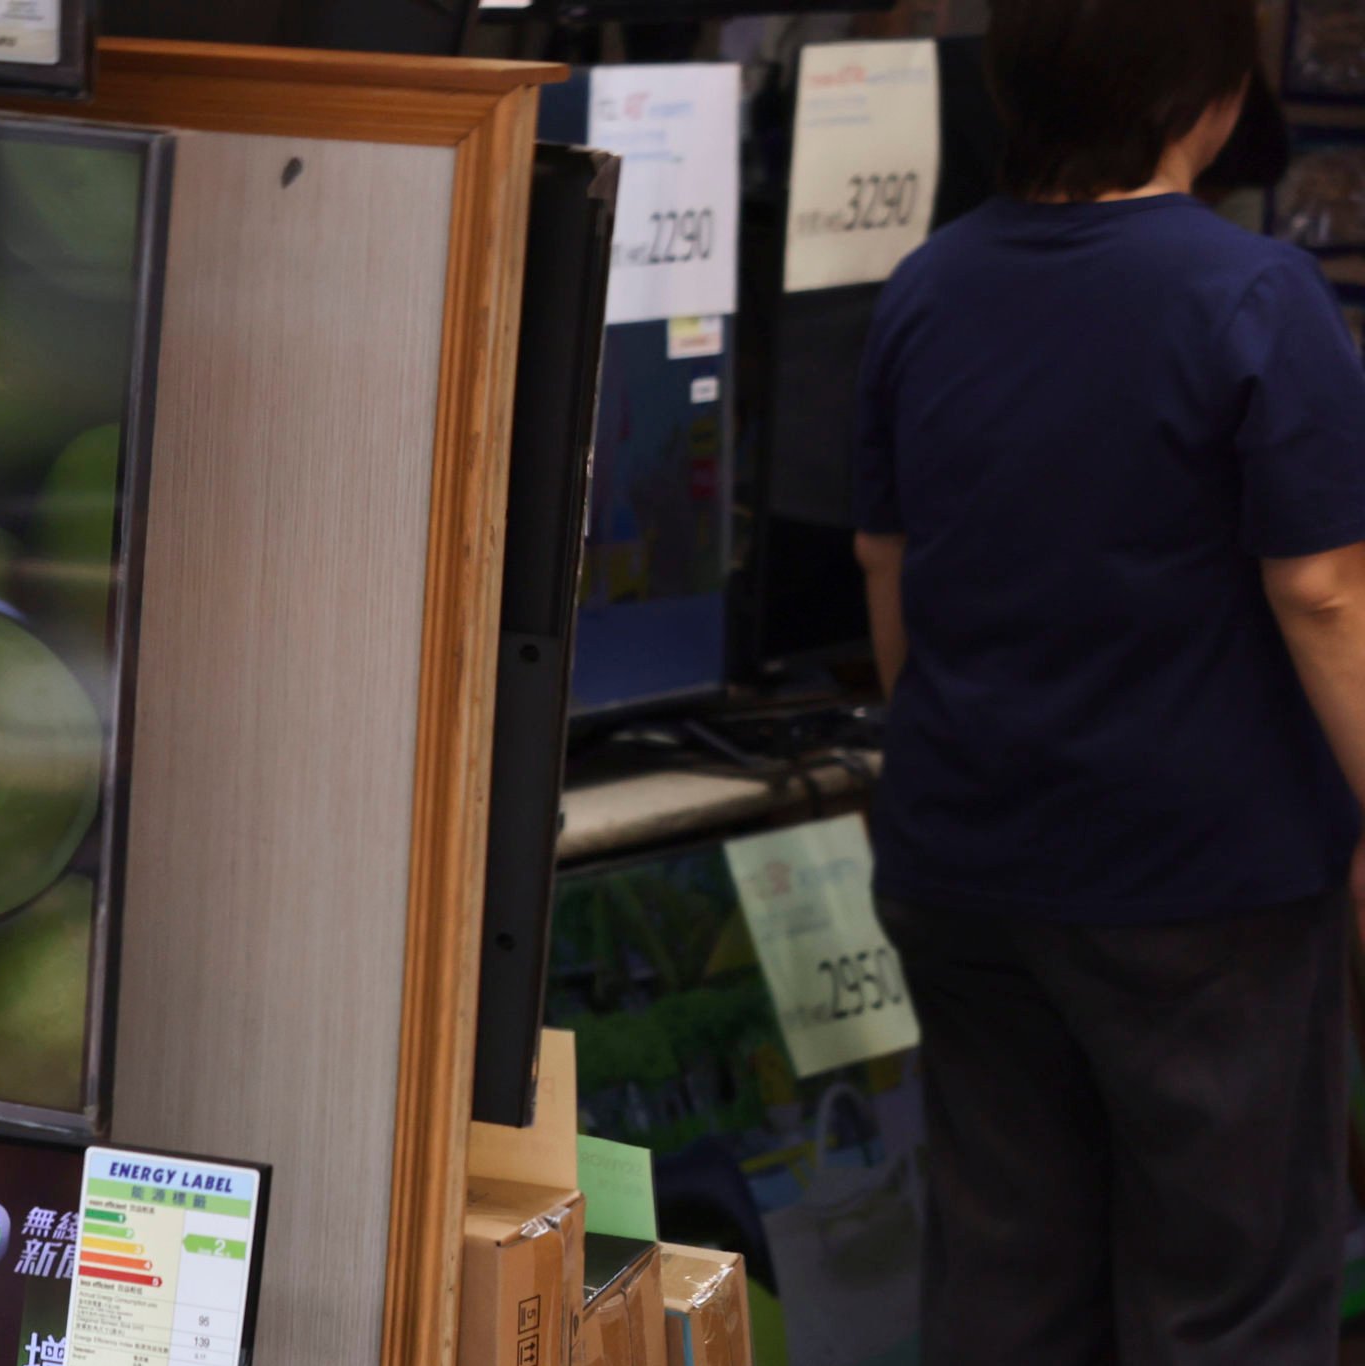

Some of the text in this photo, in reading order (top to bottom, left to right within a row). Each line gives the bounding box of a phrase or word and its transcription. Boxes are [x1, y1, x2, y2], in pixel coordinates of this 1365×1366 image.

[843, 168, 917, 231] 3290
[648, 207, 714, 265] 2290
[109, 1161, 234, 1193] ENERGY LABEL
[214, 1238, 227, 1257] 2
[193, 1336, 211, 1349] 139
